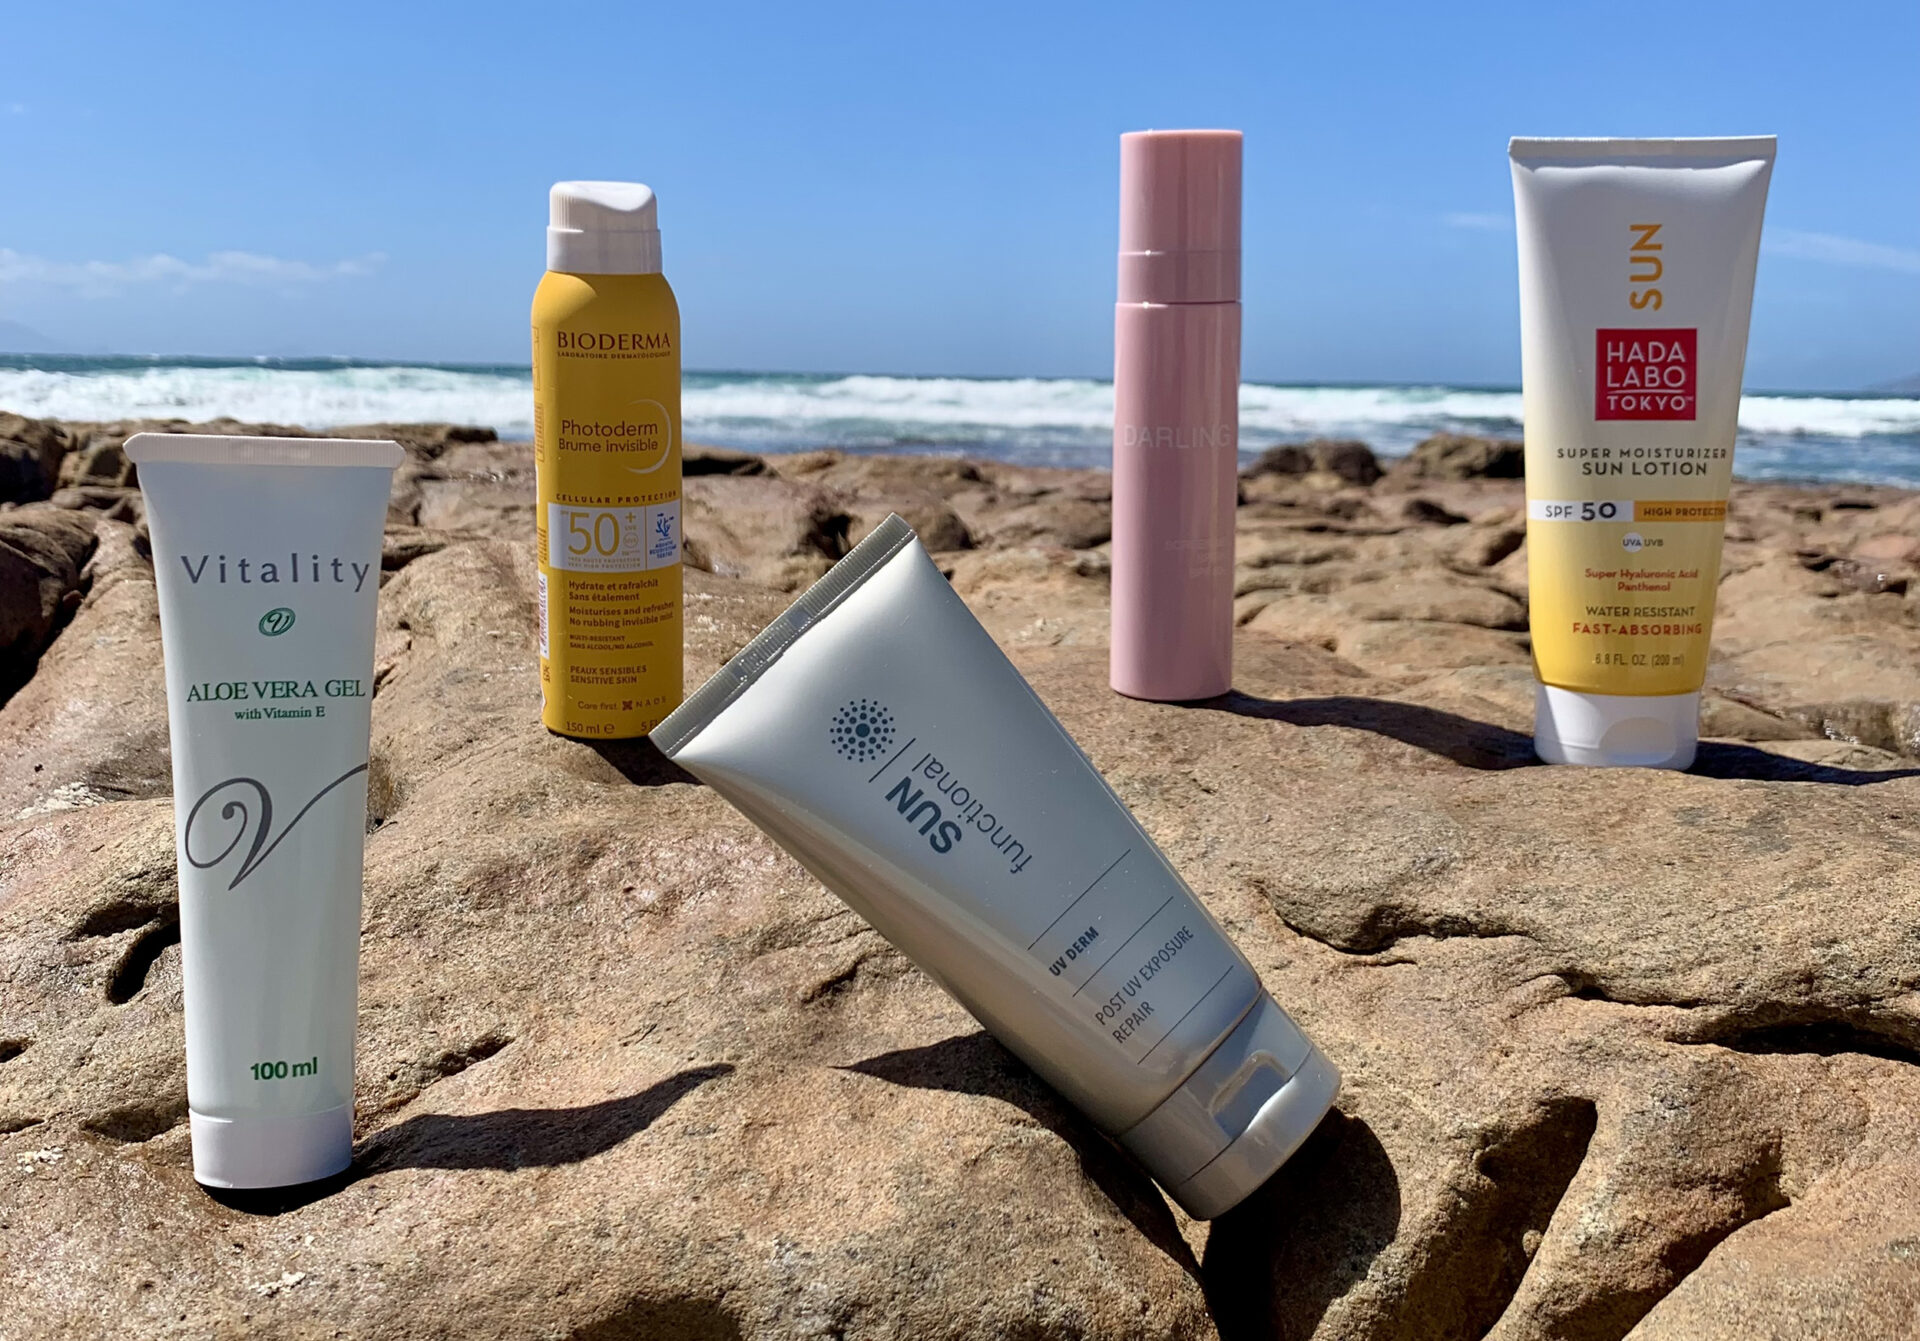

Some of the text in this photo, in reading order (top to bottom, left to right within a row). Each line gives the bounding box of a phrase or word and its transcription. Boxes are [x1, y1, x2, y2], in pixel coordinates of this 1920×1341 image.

[1629, 223, 1663, 311] SUN
[557, 331, 671, 351] BIODERMA
[1607, 341, 1686, 363] HADA
[1607, 366, 1686, 388] LABO
[562, 420, 658, 437] Photoderm
[1124, 424, 1232, 449] DARLING
[558, 438, 658, 452] Brume invisible
[1557, 448, 1726, 459] SUPER MOISTURIZER
[1582, 462, 1707, 476] SUN LOTION
[556, 493, 611, 504] CELLULAR
[1545, 502, 1617, 521] SPF 50
[1643, 507, 1726, 517] HIGH PROTECTIO
[1622, 539, 1664, 547] UVA UVB
[180, 553, 370, 593] Vitality
[1585, 568, 1698, 580] Super Hyaluronic Acid
[569, 580, 604, 592] Hydrate
[607, 582, 616, 590] et
[1618, 582, 1670, 592] Panthenol
[569, 592, 639, 602] Sans étalement
[569, 606, 620, 616] Moisturises
[624, 605, 641, 614] and
[1586, 606, 1695, 618] WATER RESISTANT
[569, 617, 581, 626] No
[584, 617, 620, 628] rubbing
[622, 615, 658, 627] invisible
[1573, 623, 1702, 635] FAST-ABSORBING
[570, 665, 647, 675] PEAUX SENSIBLES
[570, 676, 638, 685] SENSITIVE SKIN
[186, 680, 365, 702] ALOE VERA GEL
[235, 706, 325, 719] with Vitamin E
[577, 701, 598, 711] Care
[566, 721, 583, 733] 150
[586, 724, 600, 735] ml
[885, 776, 962, 854] SUN
[912, 753, 1032, 874] functional
[1049, 926, 1099, 976] UV DERM
[1095, 925, 1194, 1026] POST UV EXPOSURE
[1112, 1001, 1155, 1044] REPAIR
[250, 1057, 318, 1080] 100 ml
